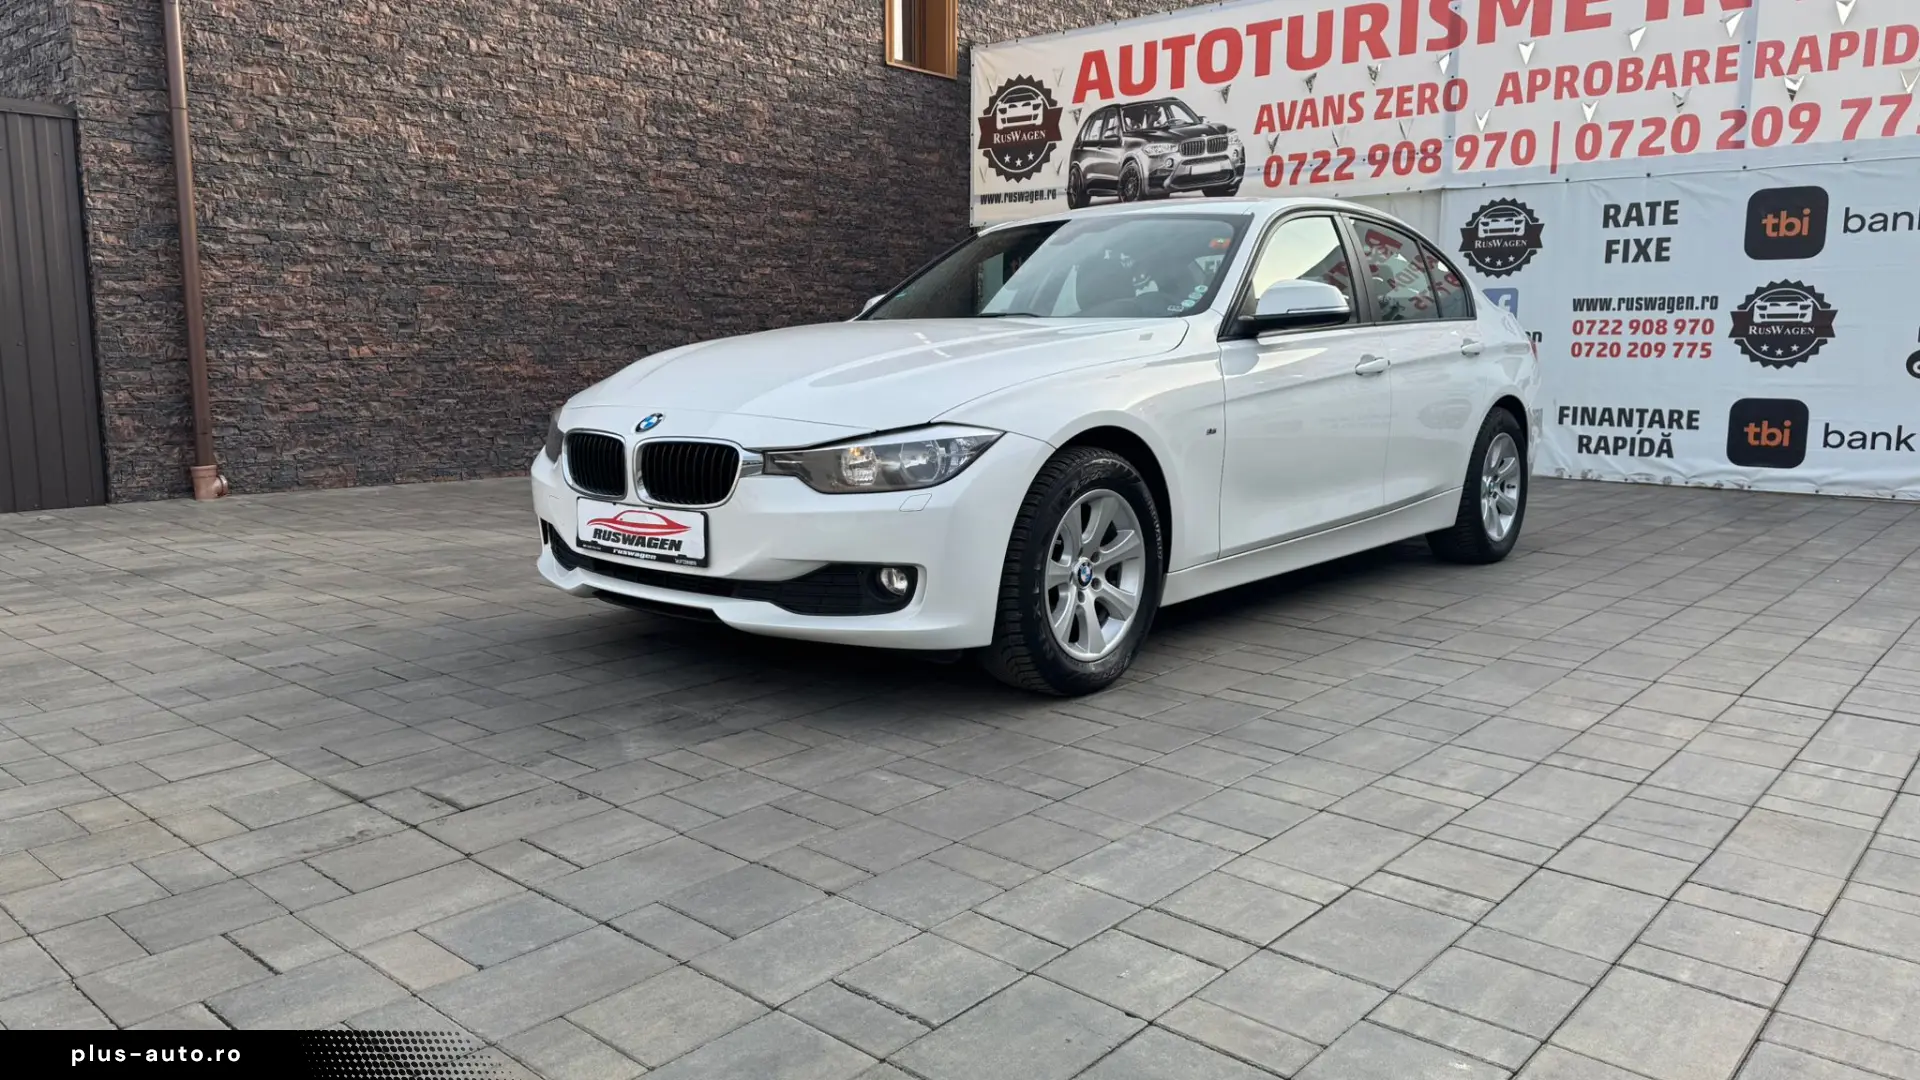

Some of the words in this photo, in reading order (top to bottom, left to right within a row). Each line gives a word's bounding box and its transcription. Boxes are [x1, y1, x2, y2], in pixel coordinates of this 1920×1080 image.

[1495, 45, 1741, 107] APROBARE
[1254, 91, 1365, 136] AVANS
[1374, 78, 1469, 121] ZERO
[1264, 147, 1356, 189] 0722
[1368, 138, 1443, 179] 908
[1455, 128, 1537, 171] 970
[1575, 113, 1701, 162] 0720
[1716, 102, 1822, 151] 209
[1841, 92, 1920, 141] 77
[980, 188, 1057, 205] www.ruswagen.ro
[1602, 200, 1679, 229] RATE
[1761, 207, 1811, 238] tbi
[1842, 206, 1920, 234] ban
[1604, 236, 1672, 264] FIXE
[1572, 295, 1719, 314] www.ruswagen.ro
[1572, 318, 1623, 336] 0722
[1628, 318, 1668, 336] 908
[1673, 318, 1715, 336] 970
[1570, 341, 1622, 358] 0720
[1626, 341, 1667, 358] 209
[1672, 341, 1713, 359] 775
[1743, 419, 1793, 447] tbi
[1822, 422, 1917, 452] bank
[592, 527, 683, 552] RUSWAGEN
[612, 548, 657, 561] ruswagen
